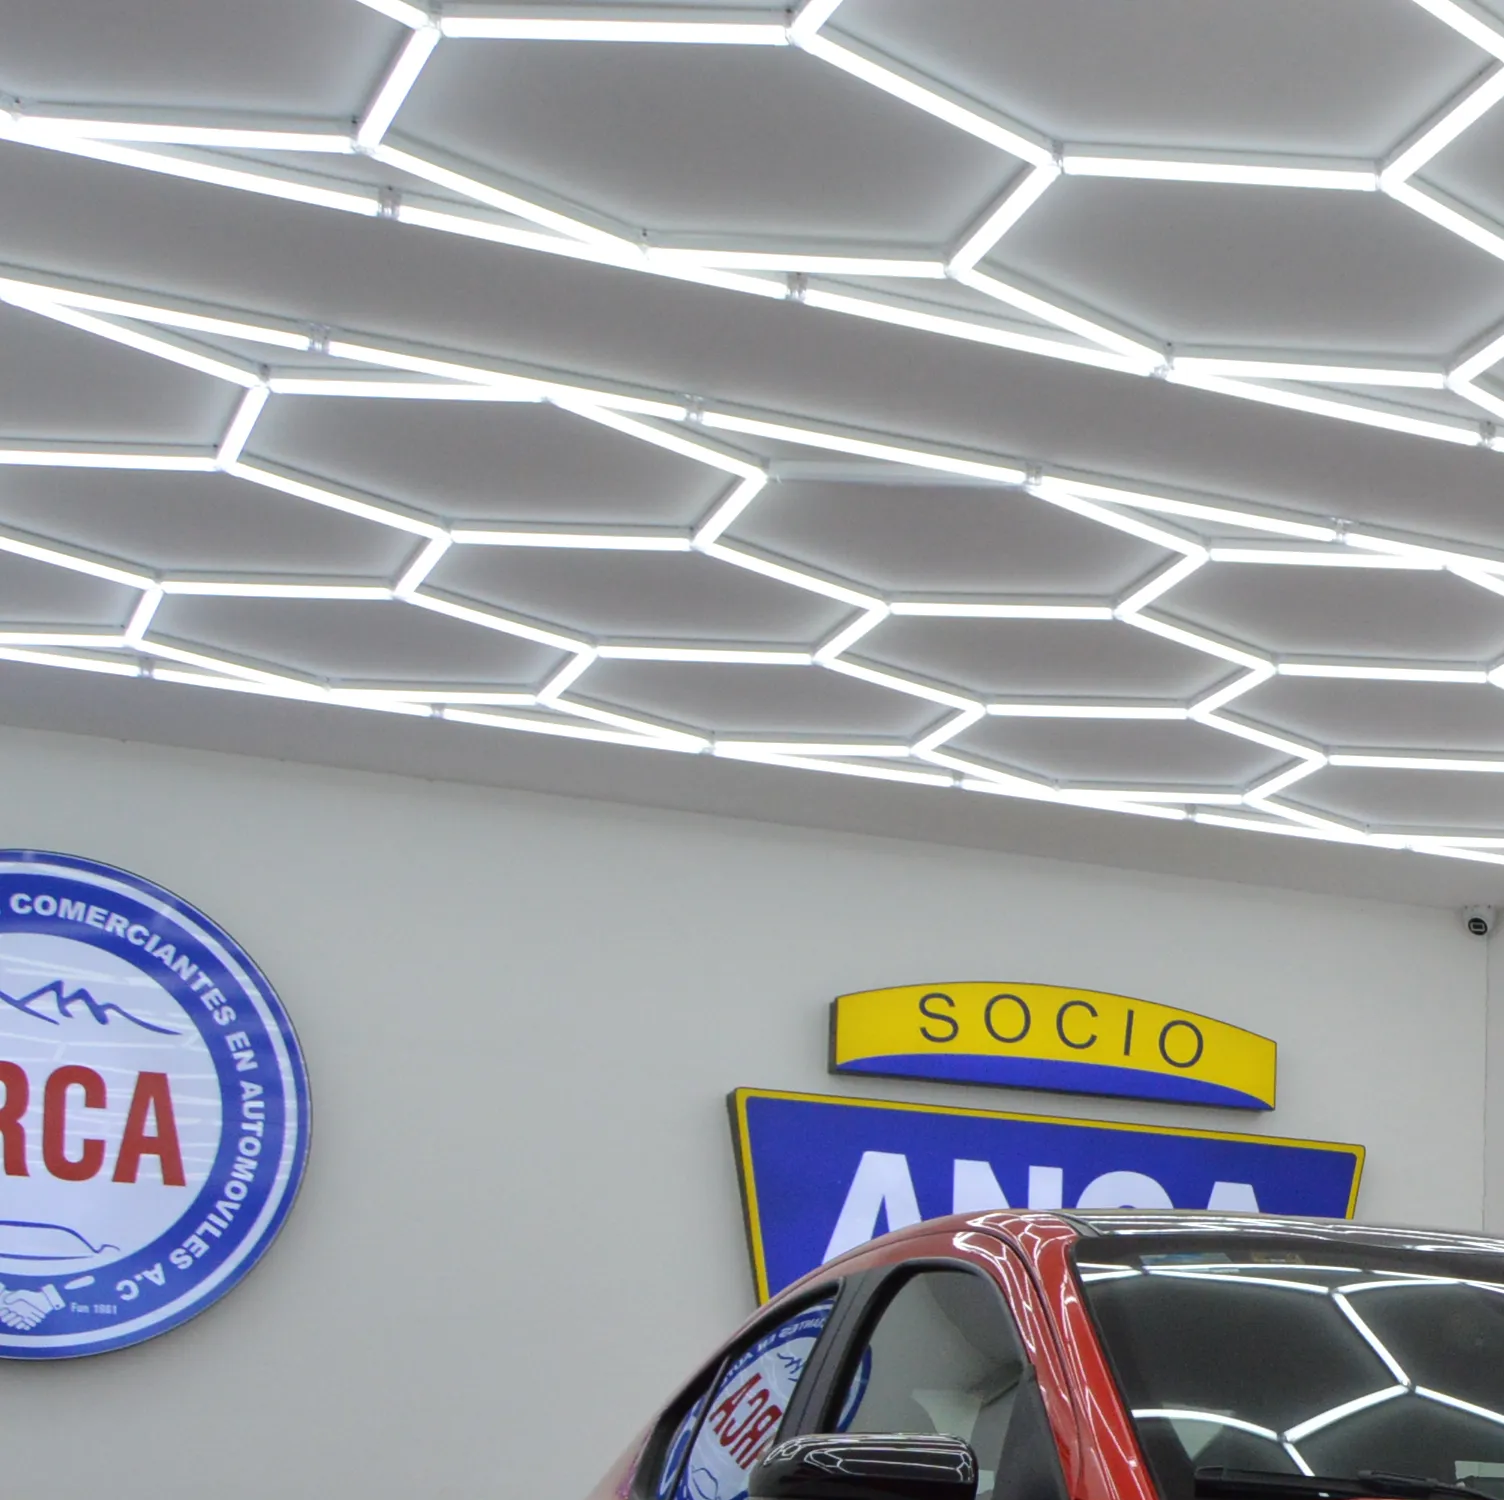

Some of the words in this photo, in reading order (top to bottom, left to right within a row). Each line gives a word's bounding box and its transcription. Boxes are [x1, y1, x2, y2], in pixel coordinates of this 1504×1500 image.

[9, 892, 238, 1026] COMERCIANTES
[224, 1031, 259, 1073] EN
[918, 992, 1204, 1069] SOCIO
[168, 1080, 266, 1270] AUTOMOVILES
